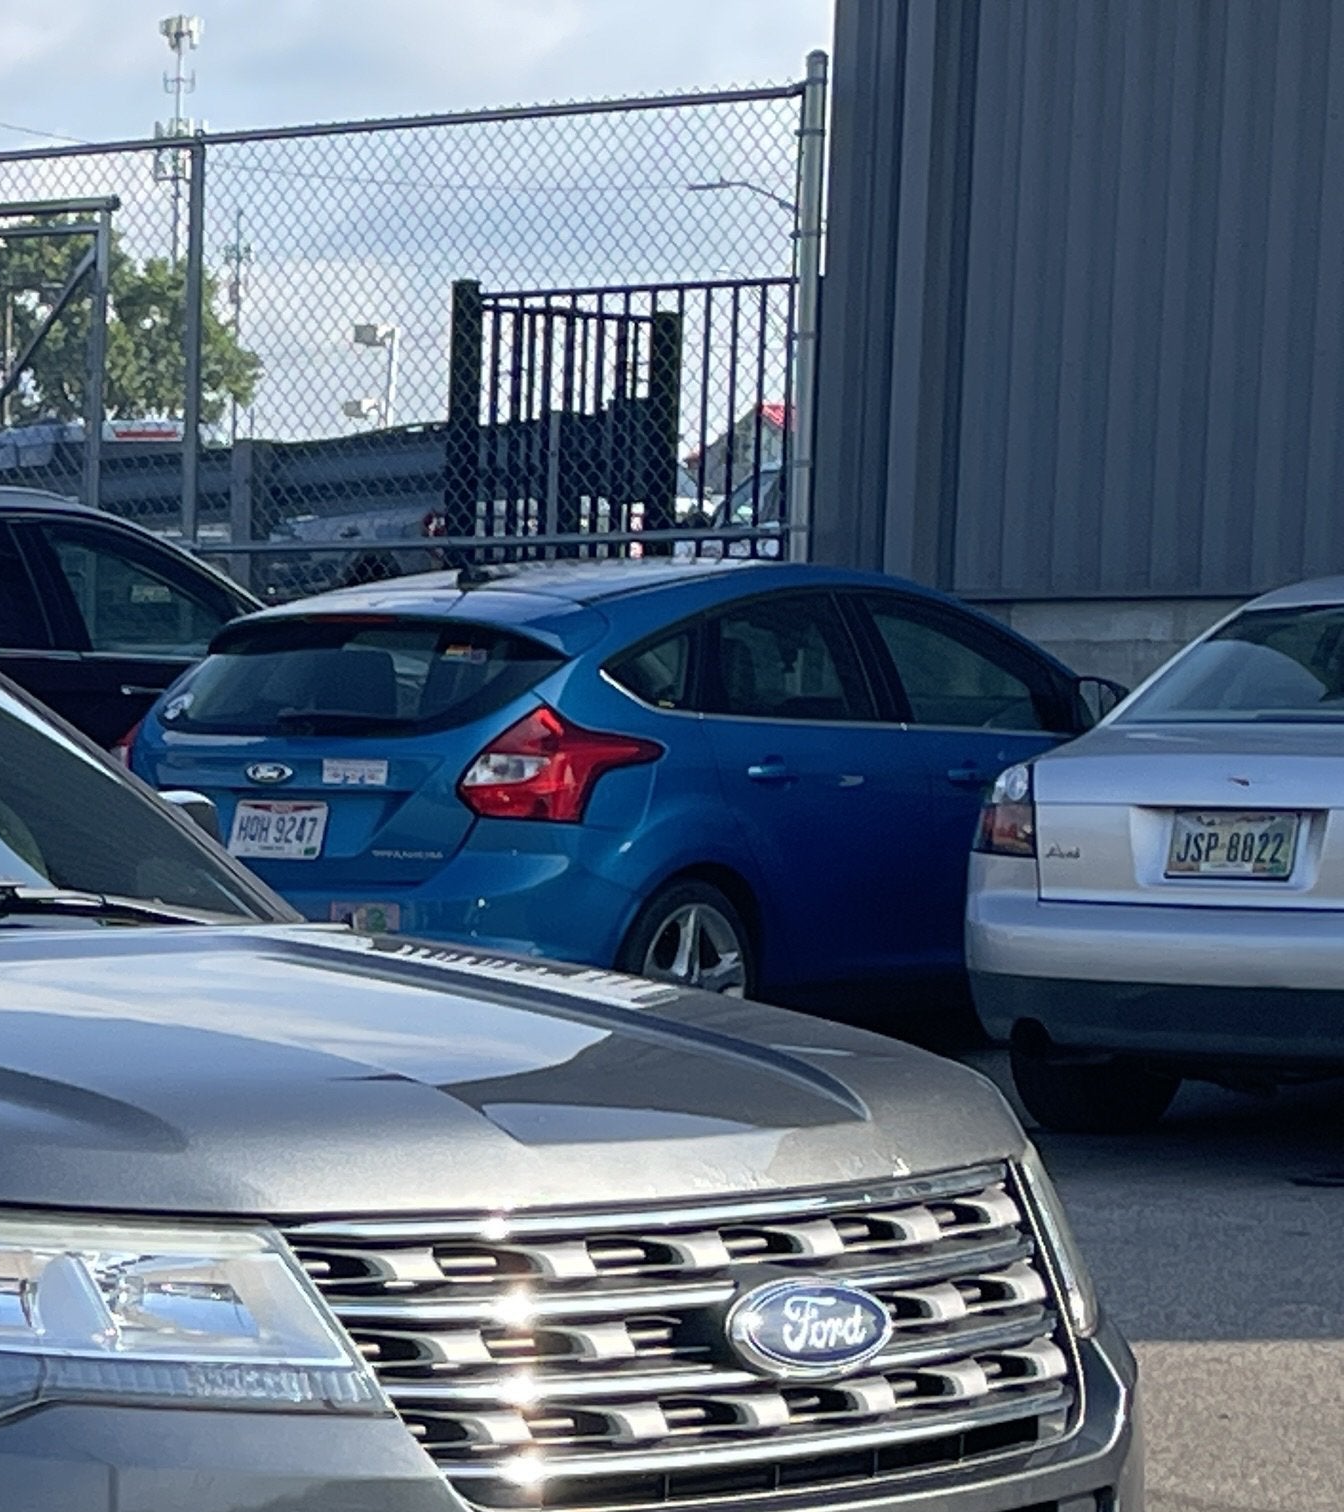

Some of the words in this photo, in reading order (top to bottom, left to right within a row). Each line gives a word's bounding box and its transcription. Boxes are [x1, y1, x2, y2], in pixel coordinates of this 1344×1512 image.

[272, 816, 318, 844] 9247
[1176, 832, 1220, 863] JSP
[782, 1295, 868, 1352] Ford
